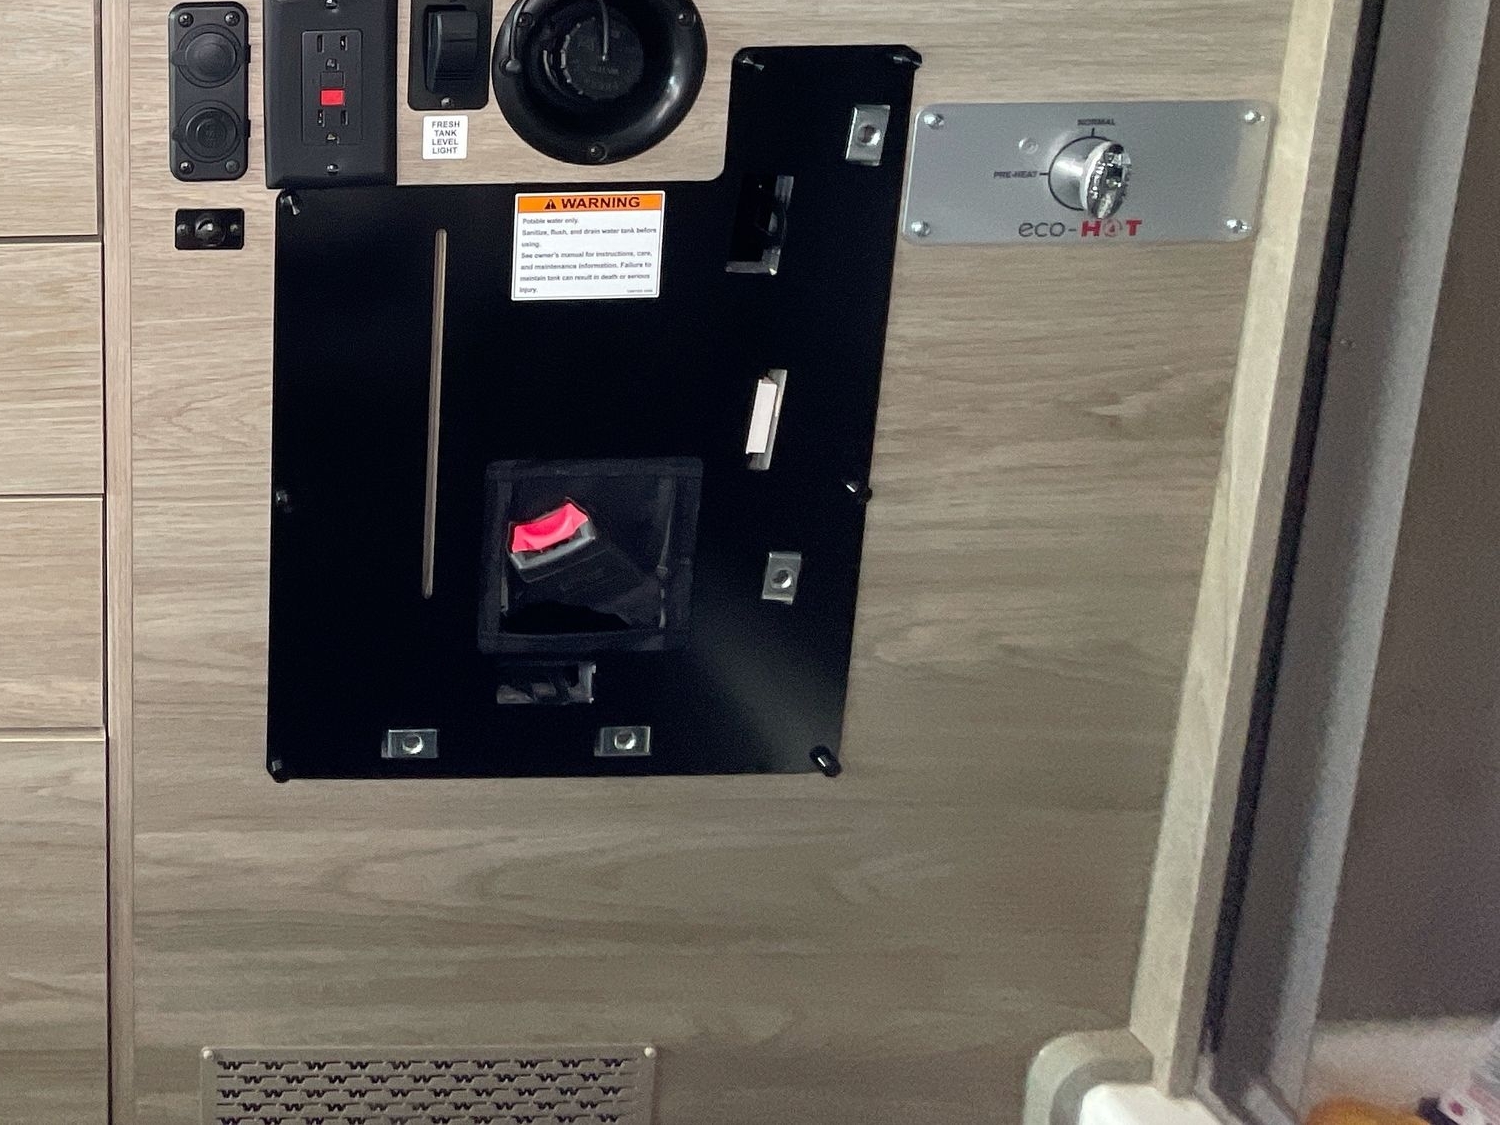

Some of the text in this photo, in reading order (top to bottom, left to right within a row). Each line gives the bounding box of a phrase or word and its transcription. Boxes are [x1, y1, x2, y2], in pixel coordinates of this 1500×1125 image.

[1077, 118, 1116, 126] NORMAL
[993, 171, 1039, 179] PRE-HEAT
[561, 197, 640, 209] WARNING
